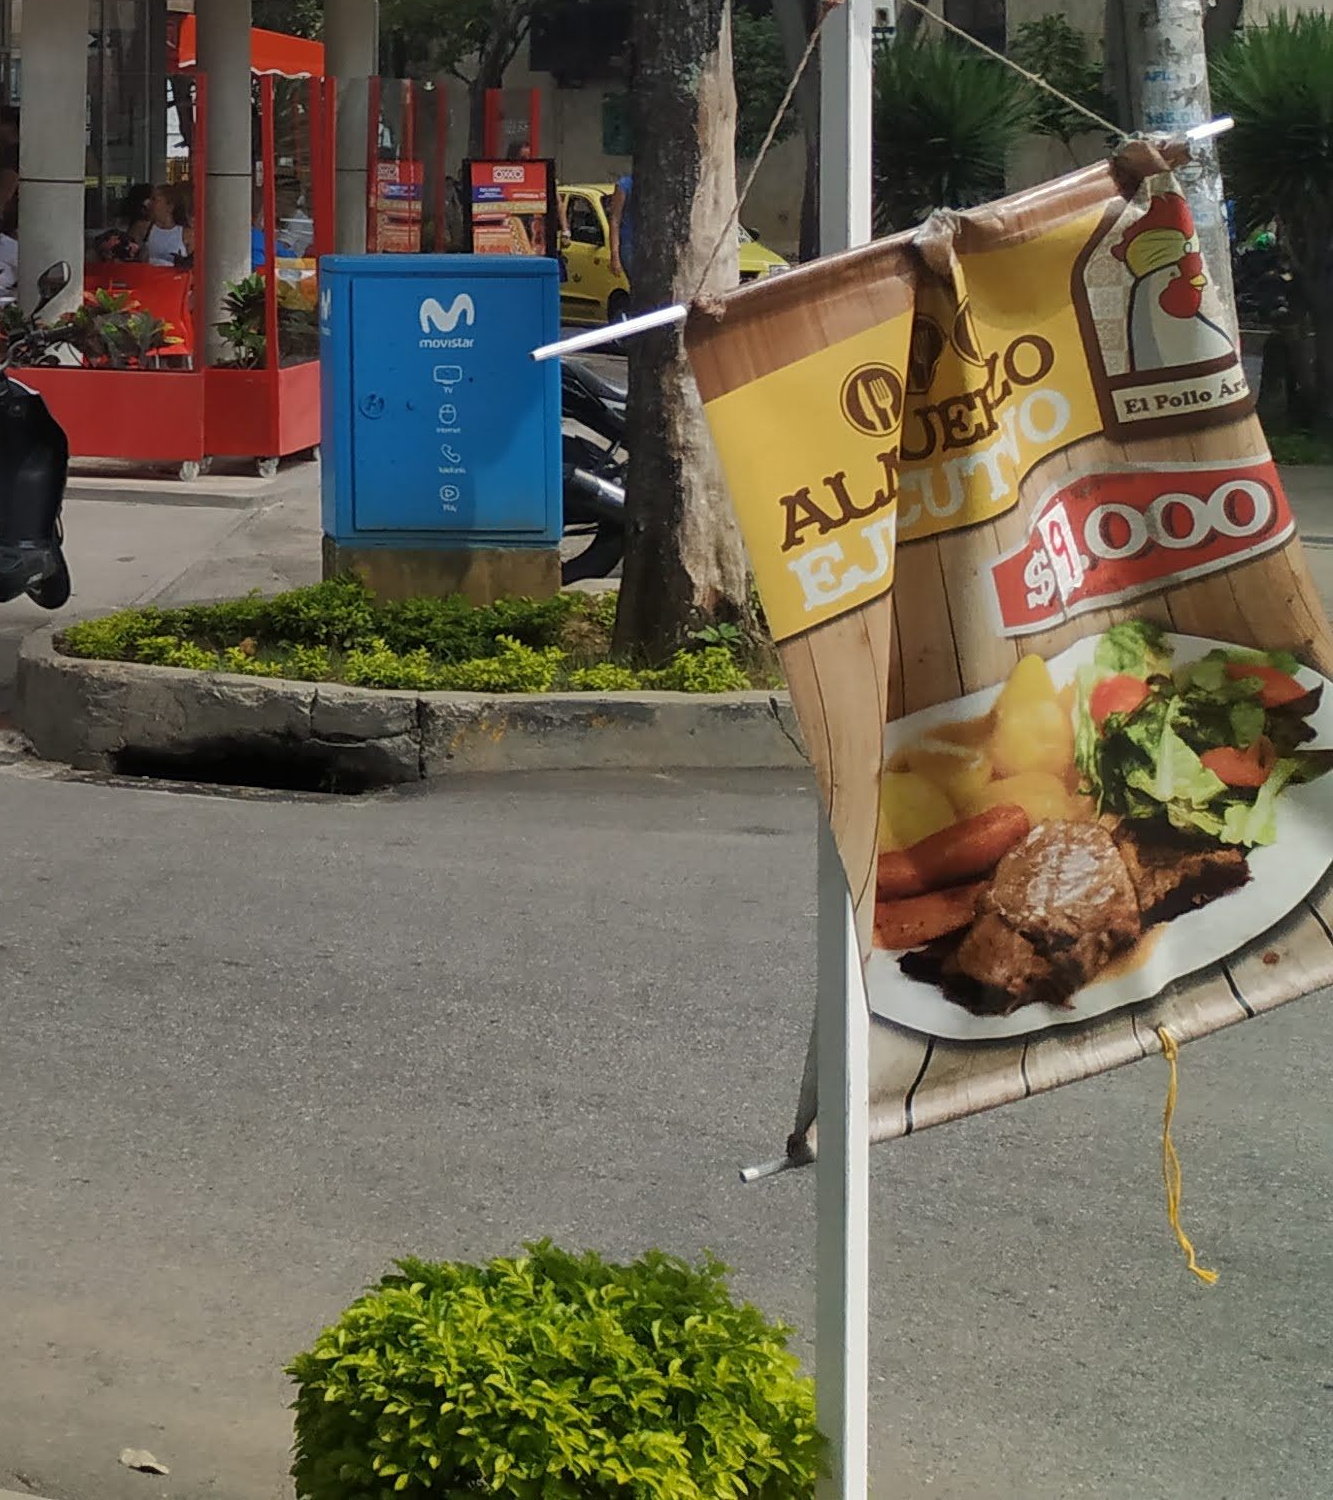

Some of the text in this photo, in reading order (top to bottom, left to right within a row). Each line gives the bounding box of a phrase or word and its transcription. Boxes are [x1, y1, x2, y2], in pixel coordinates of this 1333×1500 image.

[419, 337, 475, 349] movistar
[1123, 397, 1150, 415] El
[1154, 389, 1213, 411] Pollo
[778, 334, 1055, 552] ALUEO
